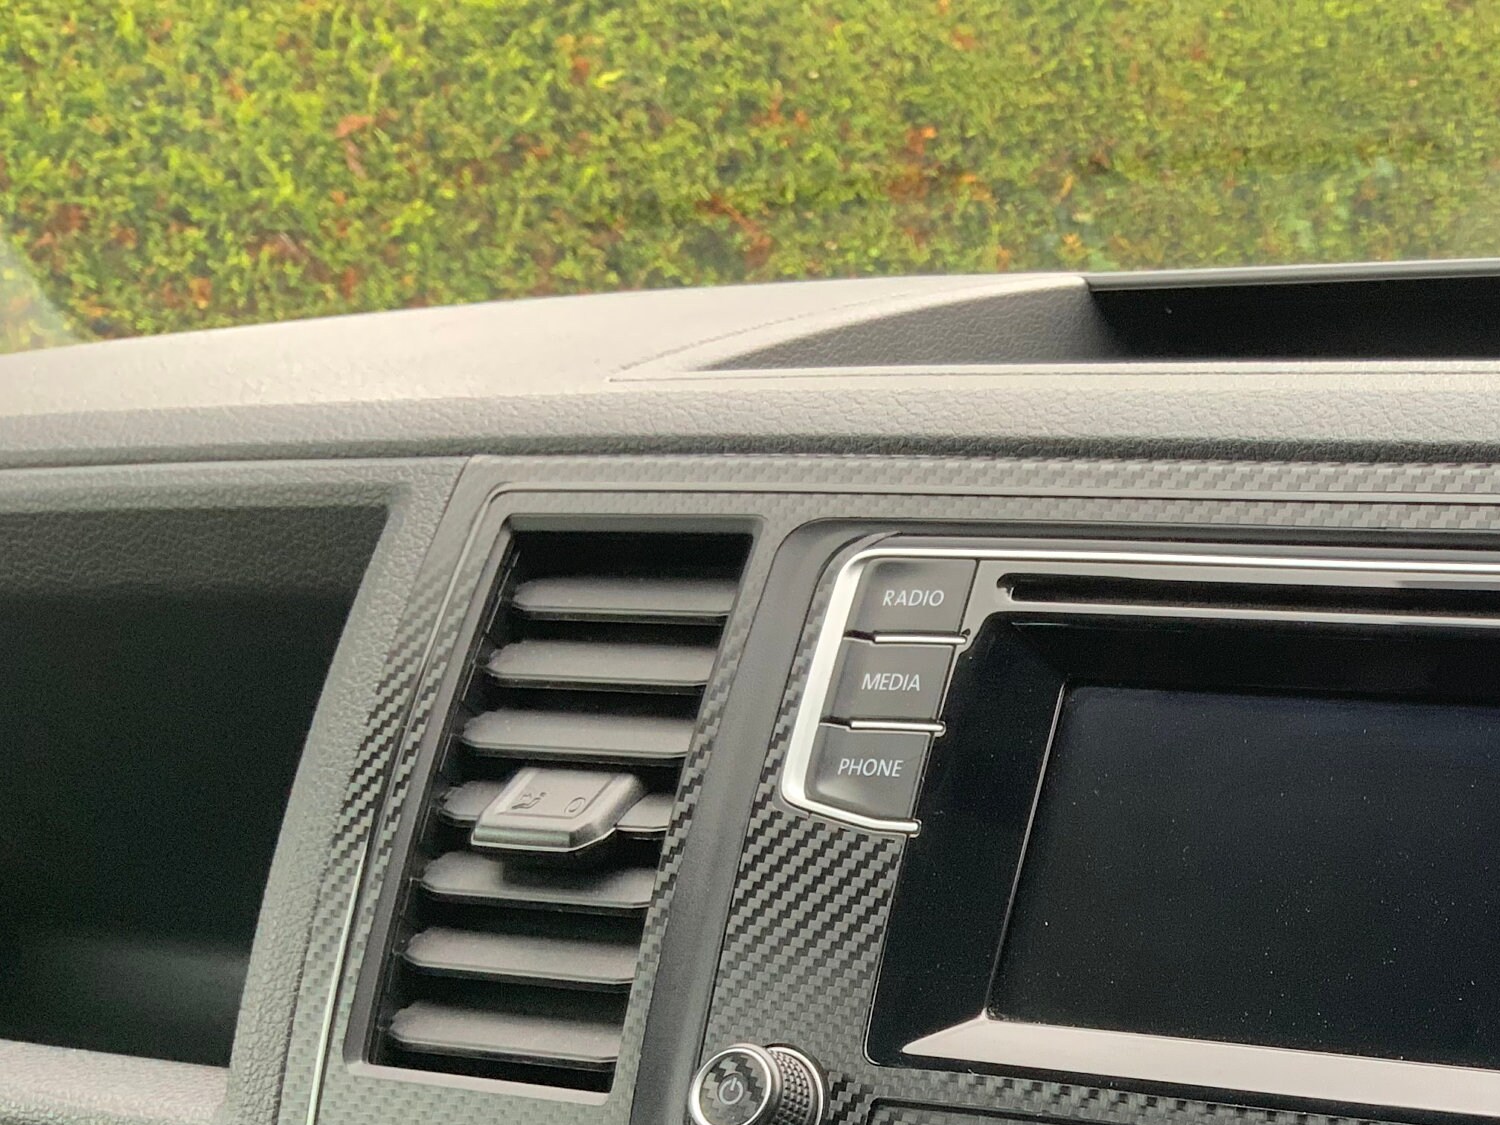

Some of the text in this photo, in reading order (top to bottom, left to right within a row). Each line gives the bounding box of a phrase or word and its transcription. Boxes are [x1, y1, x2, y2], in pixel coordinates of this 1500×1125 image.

[882, 589, 944, 607] RADIO
[861, 673, 921, 691] MEDIA
[837, 758, 903, 778] PHONE
